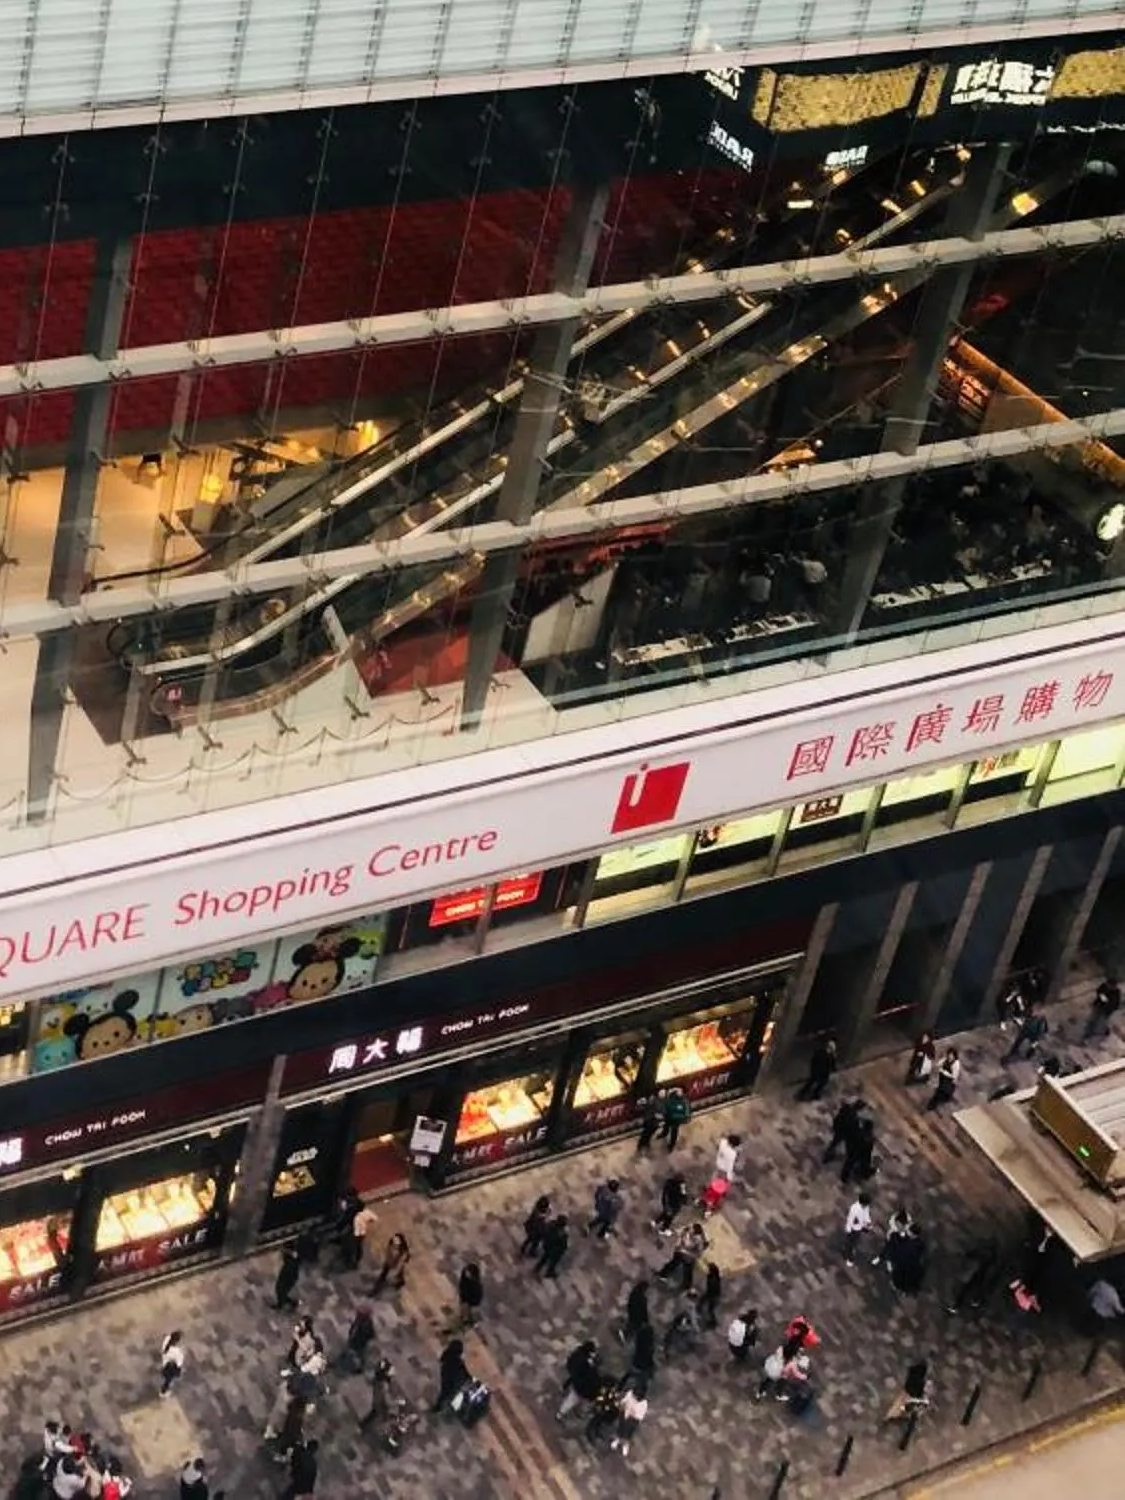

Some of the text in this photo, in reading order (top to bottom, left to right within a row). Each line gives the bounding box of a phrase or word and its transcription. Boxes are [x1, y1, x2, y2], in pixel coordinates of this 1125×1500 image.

[786, 669, 1115, 780] 國際廣場購物
[173, 864, 355, 926] Shopping
[367, 828, 499, 878] Centre
[44, 1127, 83, 1146] CHOW
[157, 1227, 208, 1251] SALE
[9, 1272, 63, 1300] SALE
